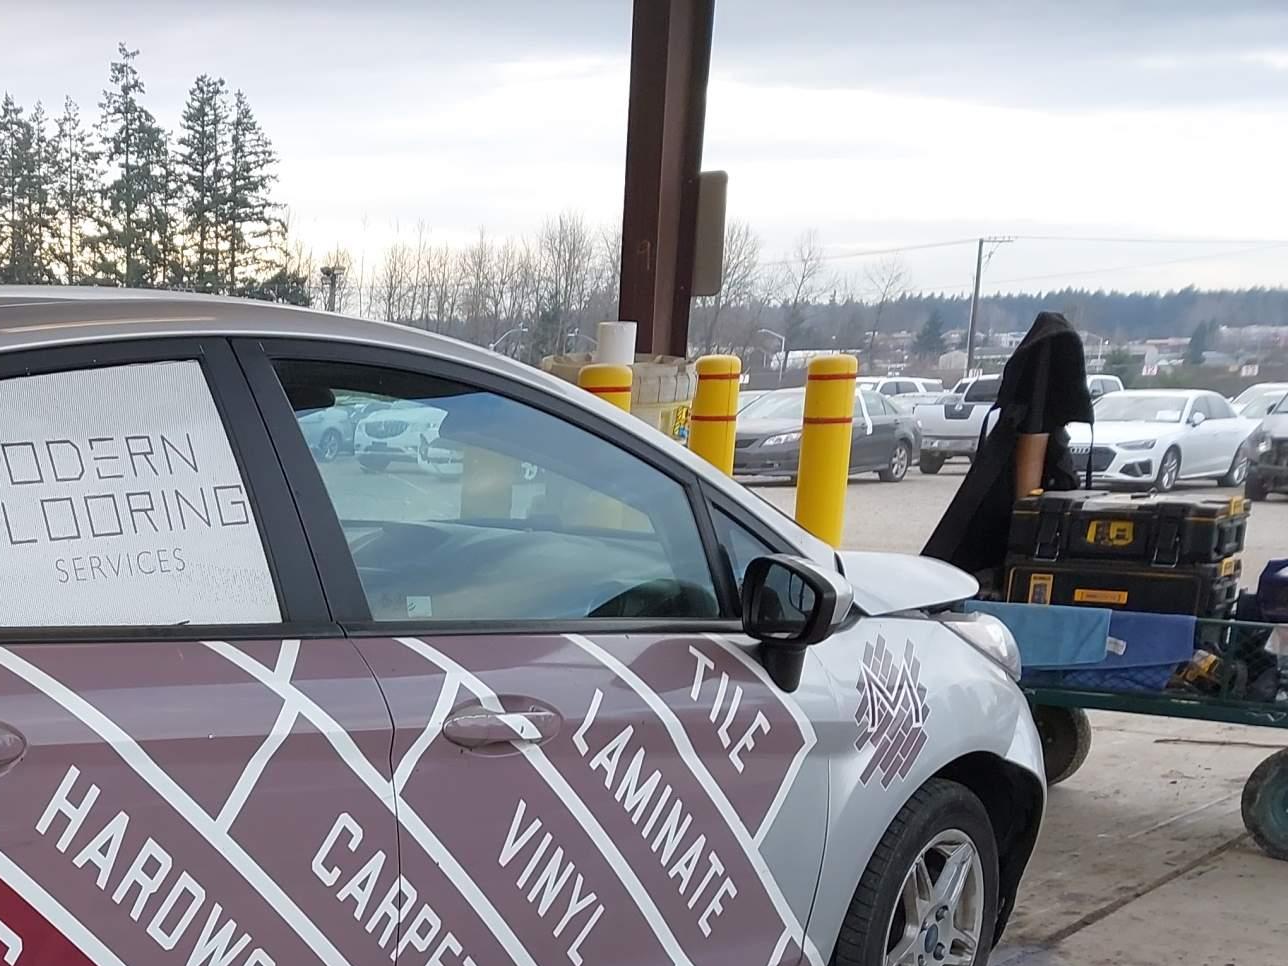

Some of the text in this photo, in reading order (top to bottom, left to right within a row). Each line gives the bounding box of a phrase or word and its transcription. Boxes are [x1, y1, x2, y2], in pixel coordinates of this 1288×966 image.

[55, 548, 186, 583] SERVICES
[688, 645, 771, 773] TILE
[572, 688, 738, 937] LAMINATE
